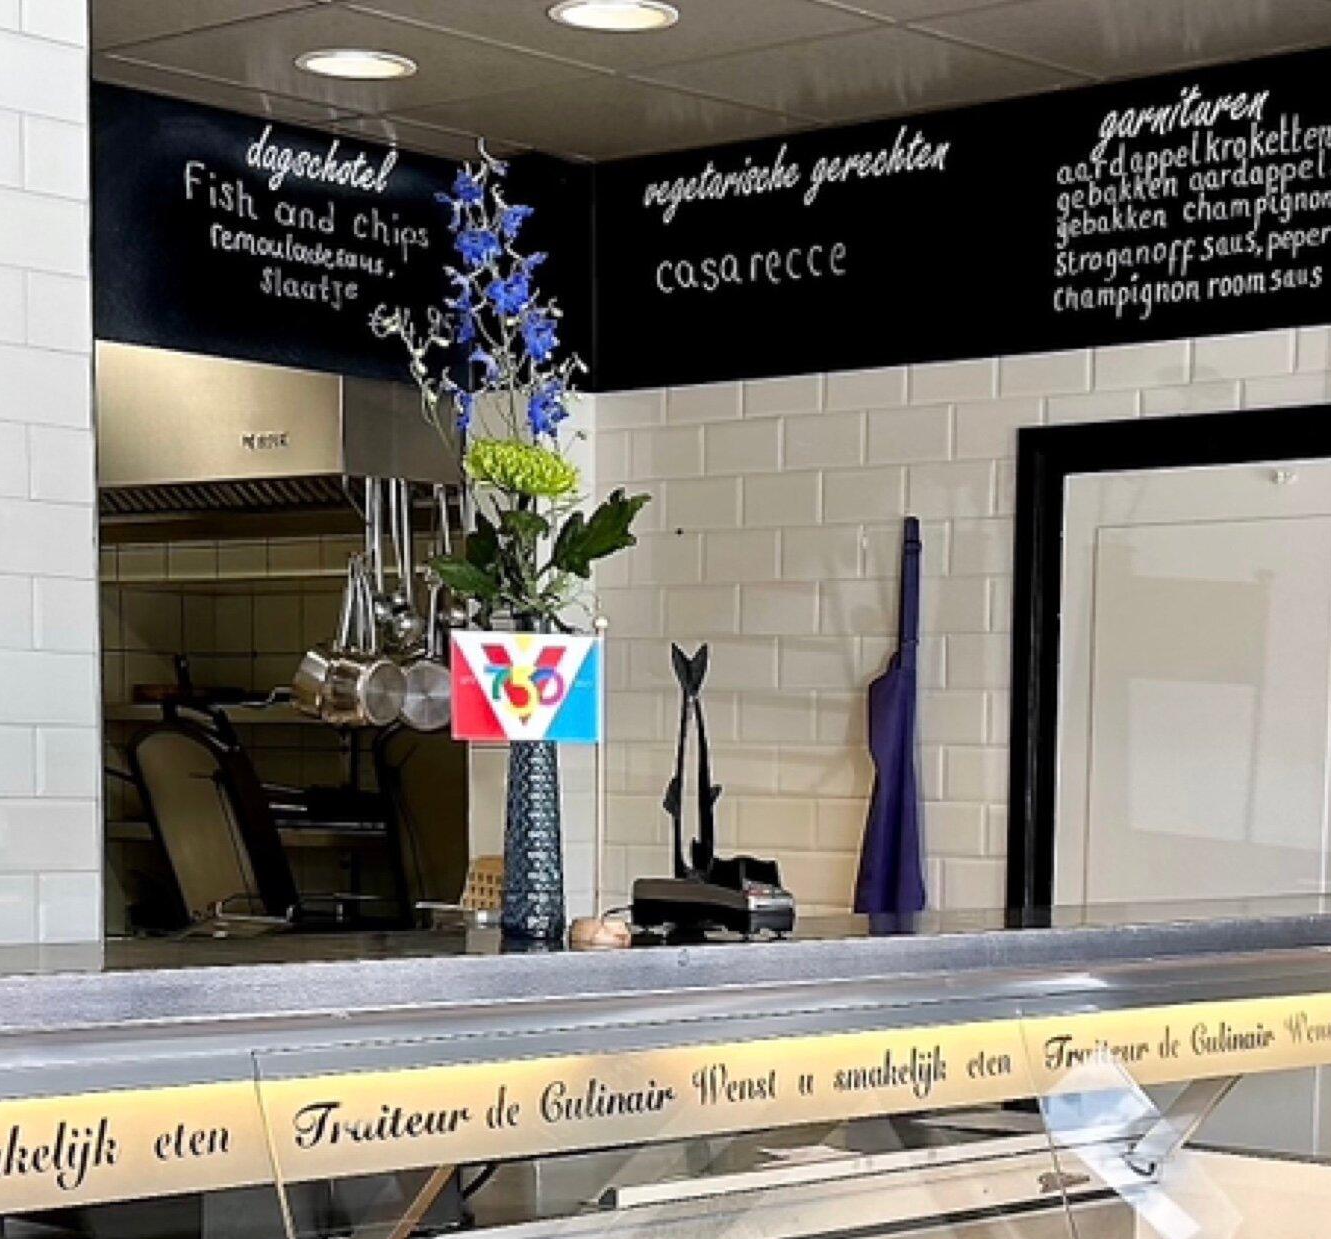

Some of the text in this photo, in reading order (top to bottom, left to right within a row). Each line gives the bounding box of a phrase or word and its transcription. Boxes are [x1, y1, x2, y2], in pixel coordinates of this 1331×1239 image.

[1089, 84, 1271, 162] garnituren
[246, 125, 400, 193] dagschotel
[642, 124, 952, 224] vegetarische gerechten
[184, 160, 430, 263] Fish and chips
[1056, 173, 1179, 221] gebakken
[1056, 204, 1168, 250] gebakken
[656, 242, 847, 294] casarecce
[1157, 1025, 1181, 1060] de
[1190, 1021, 1277, 1057] Culinair
[292, 1044, 1013, 1150] Traiteur de Culinair Wenst u smakelijk eten
[152, 1122, 231, 1161] eten
